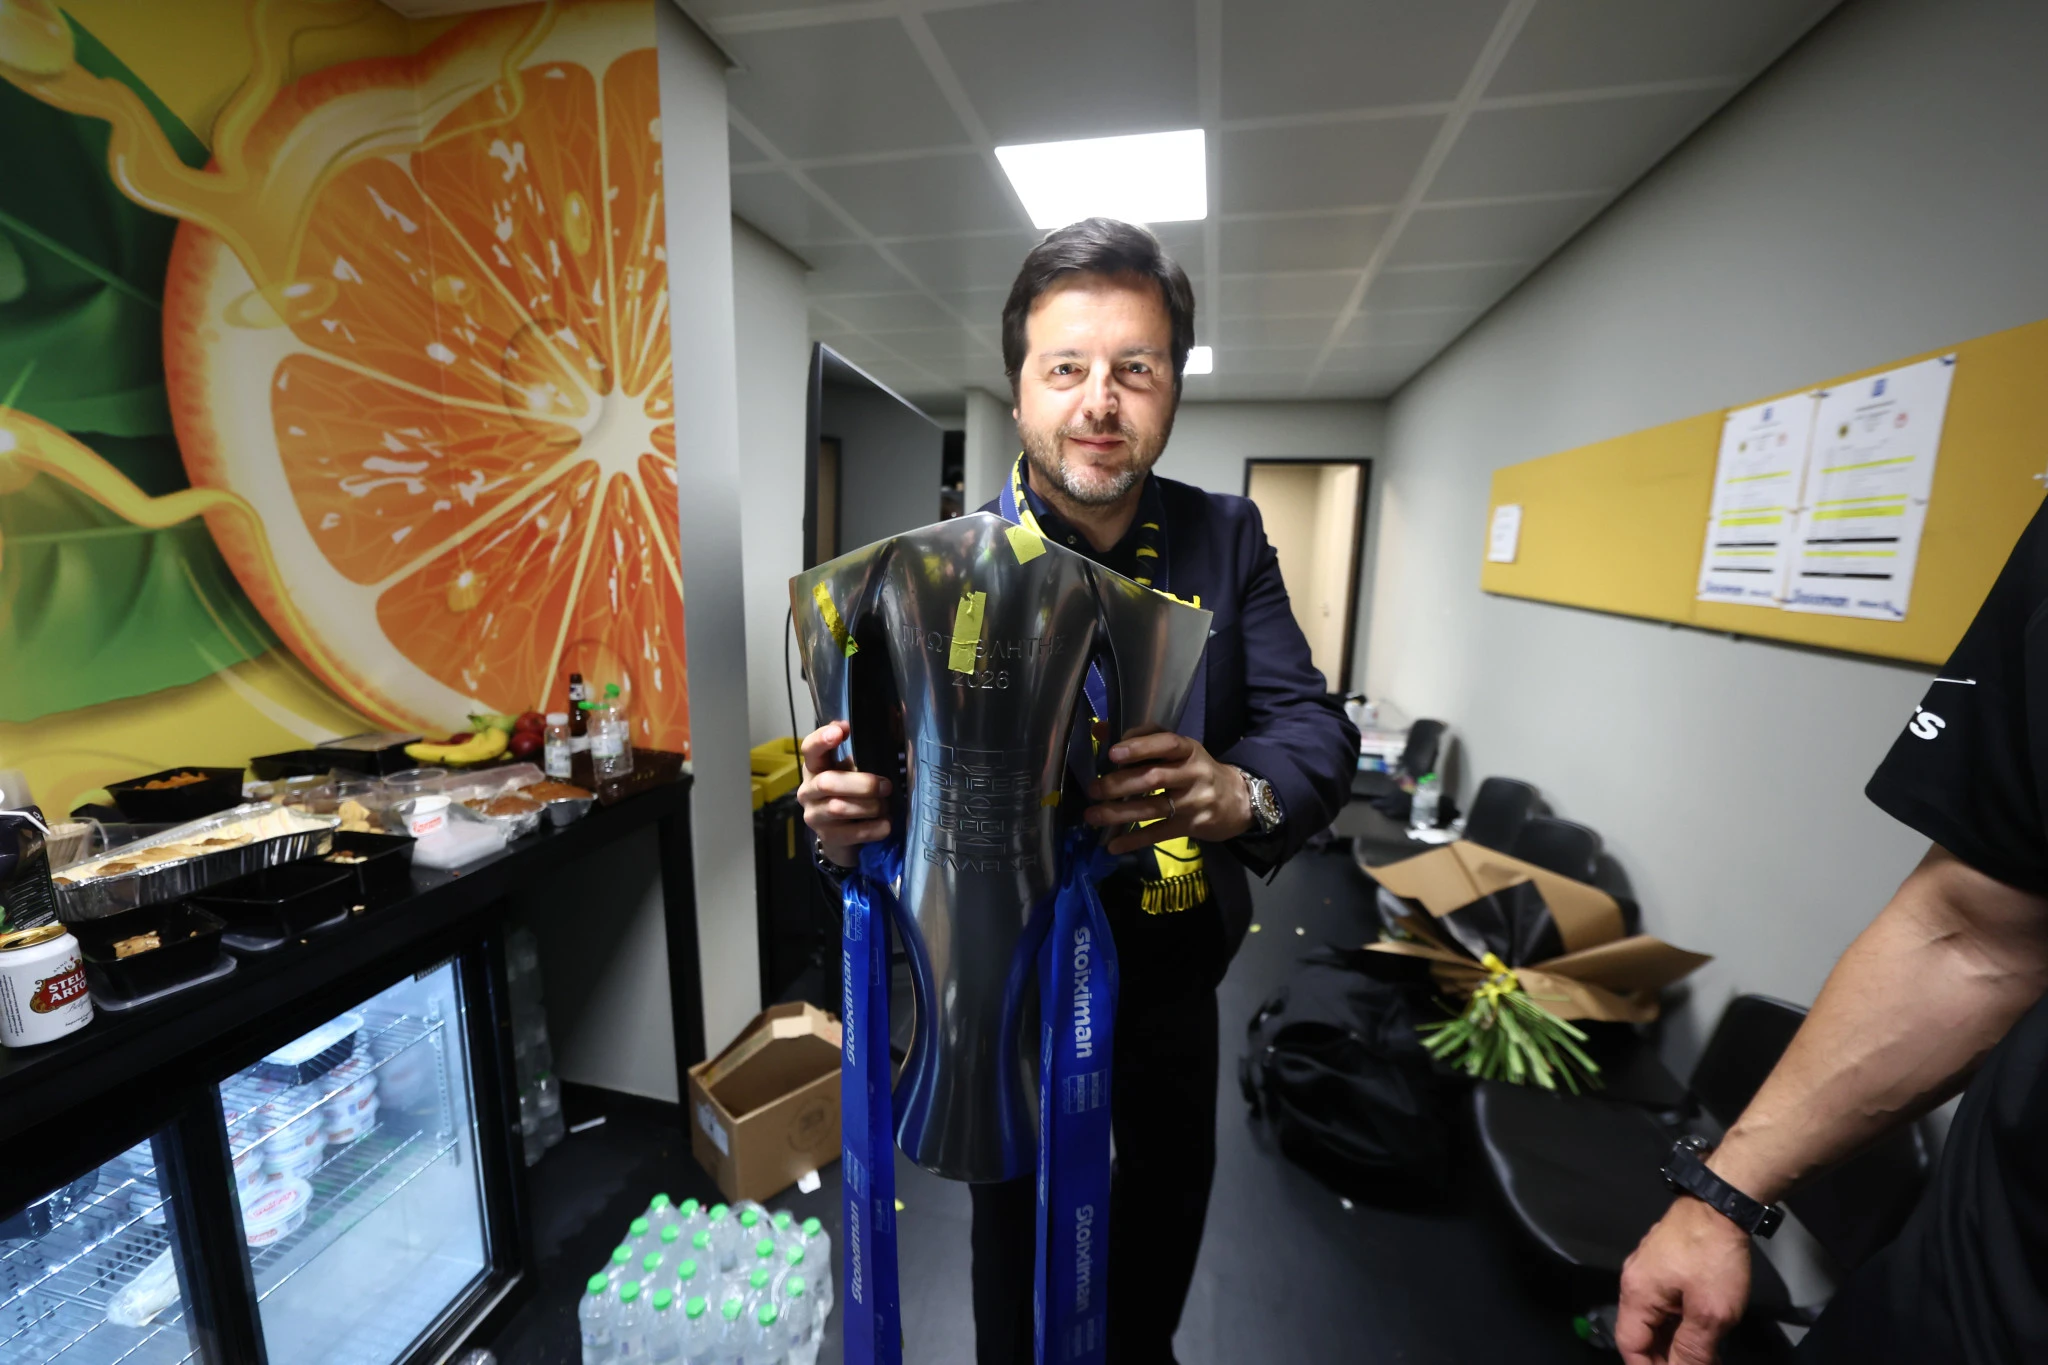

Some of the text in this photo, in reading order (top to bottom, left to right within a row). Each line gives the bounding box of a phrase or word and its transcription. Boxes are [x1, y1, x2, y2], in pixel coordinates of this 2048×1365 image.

[952, 670, 1010, 690] 2026
[48, 970, 86, 994] STELL
[50, 979, 87, 1004] ARTO
[843, 951, 857, 1067] Stoiximan
[1072, 926, 1093, 1059] Stoiximan
[849, 1200, 862, 1305] Stoiximan
[1074, 1204, 1094, 1313] Stoiximan
